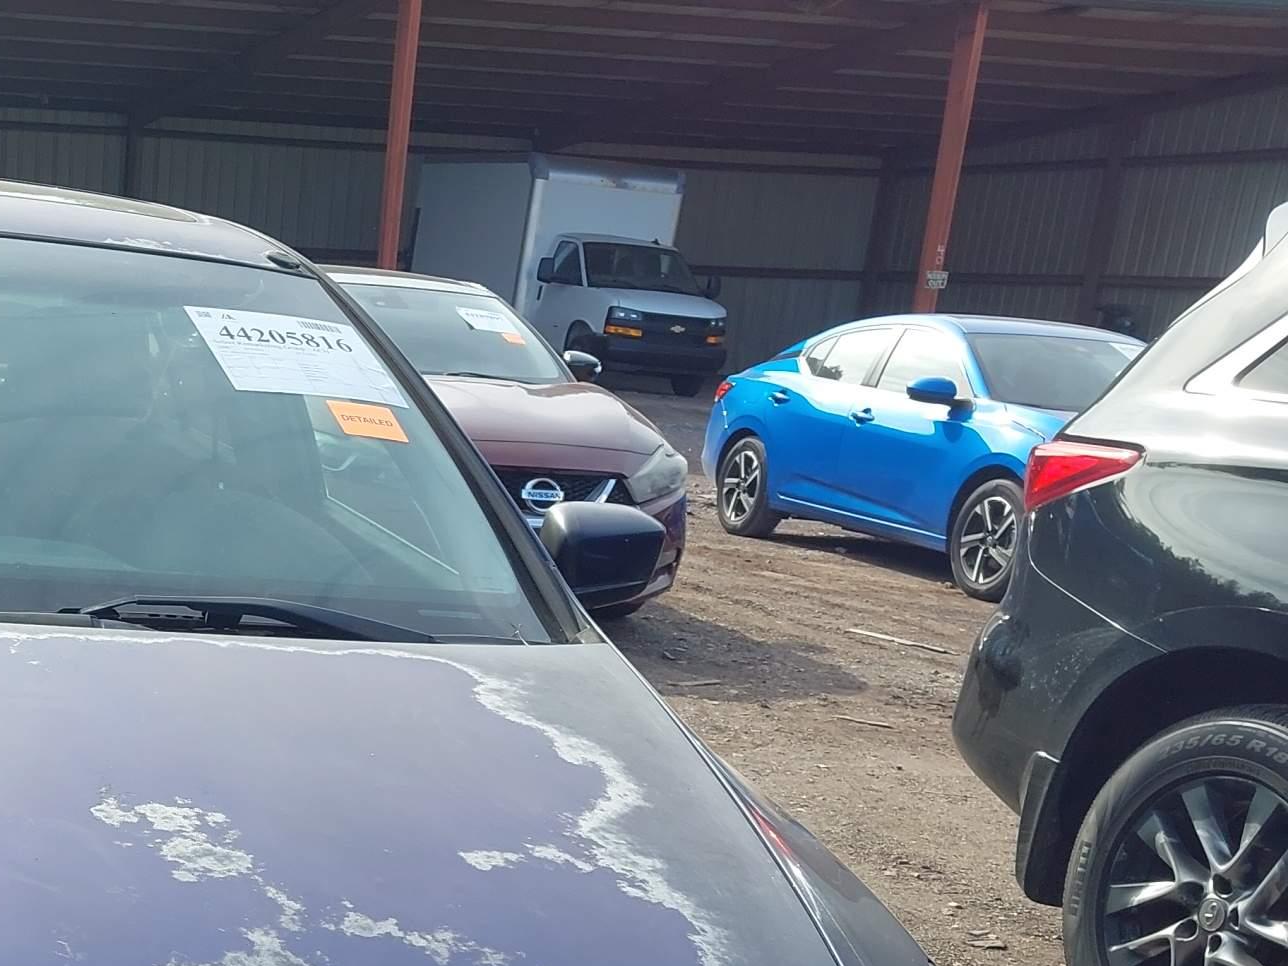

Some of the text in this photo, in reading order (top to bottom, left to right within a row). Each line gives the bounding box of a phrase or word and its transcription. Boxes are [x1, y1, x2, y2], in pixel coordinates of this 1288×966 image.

[219, 325, 353, 353] 44205816
[340, 414, 393, 427] DETAILED
[527, 491, 561, 499] NISSAN
